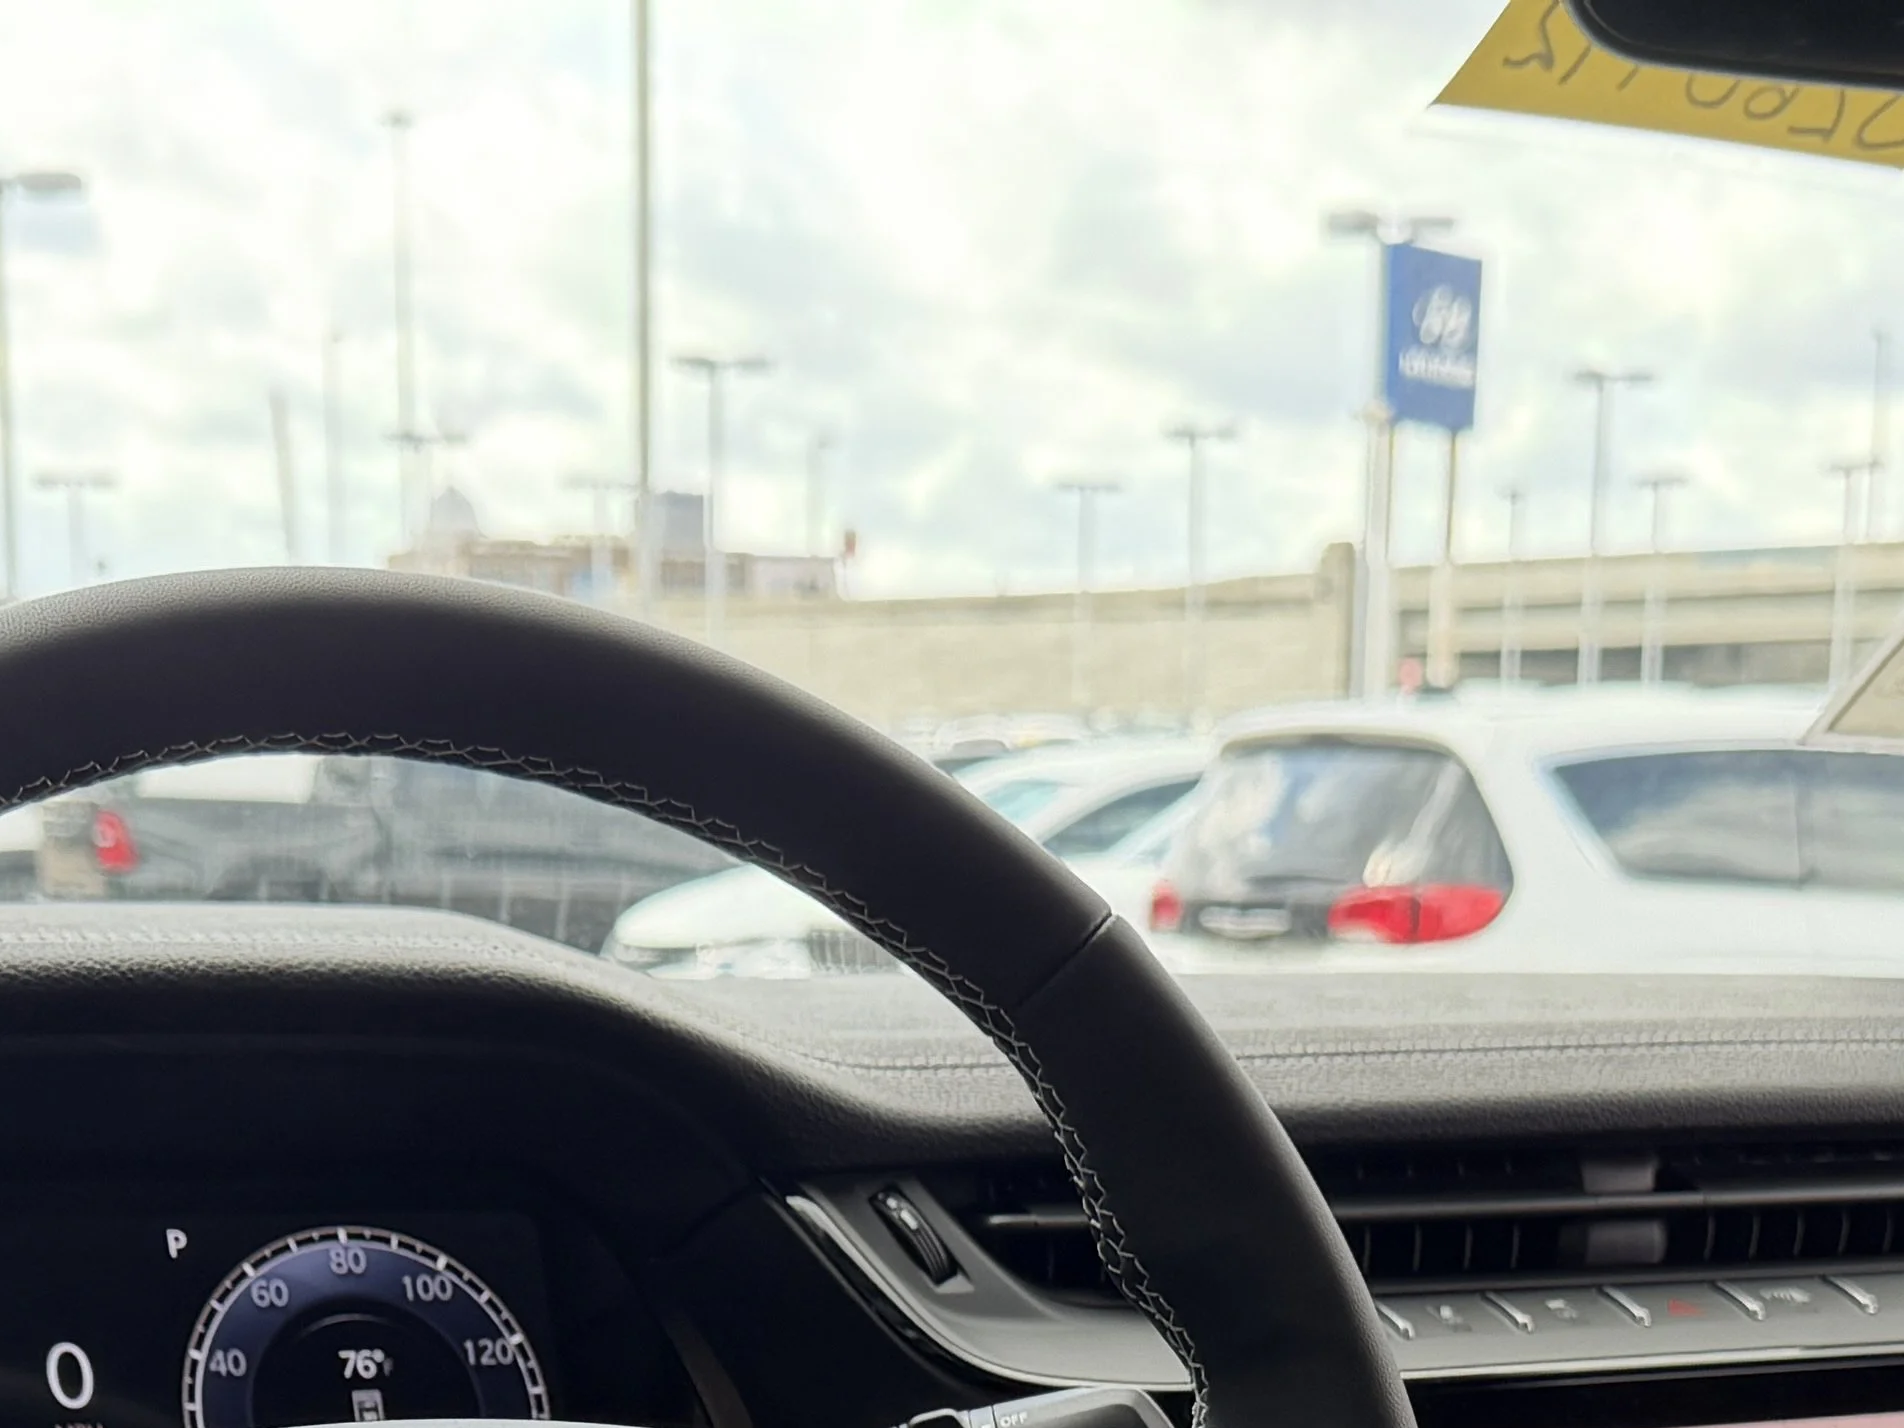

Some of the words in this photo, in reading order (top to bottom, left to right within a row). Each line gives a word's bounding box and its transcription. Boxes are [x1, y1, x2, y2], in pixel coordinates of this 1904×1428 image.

[165, 1229, 188, 1258] P
[328, 1247, 368, 1276] 80
[249, 1278, 289, 1308] 60
[399, 1274, 453, 1303] 100
[208, 1346, 248, 1378] 40
[463, 1337, 514, 1368] 120
[46, 1341, 94, 1410] 0
